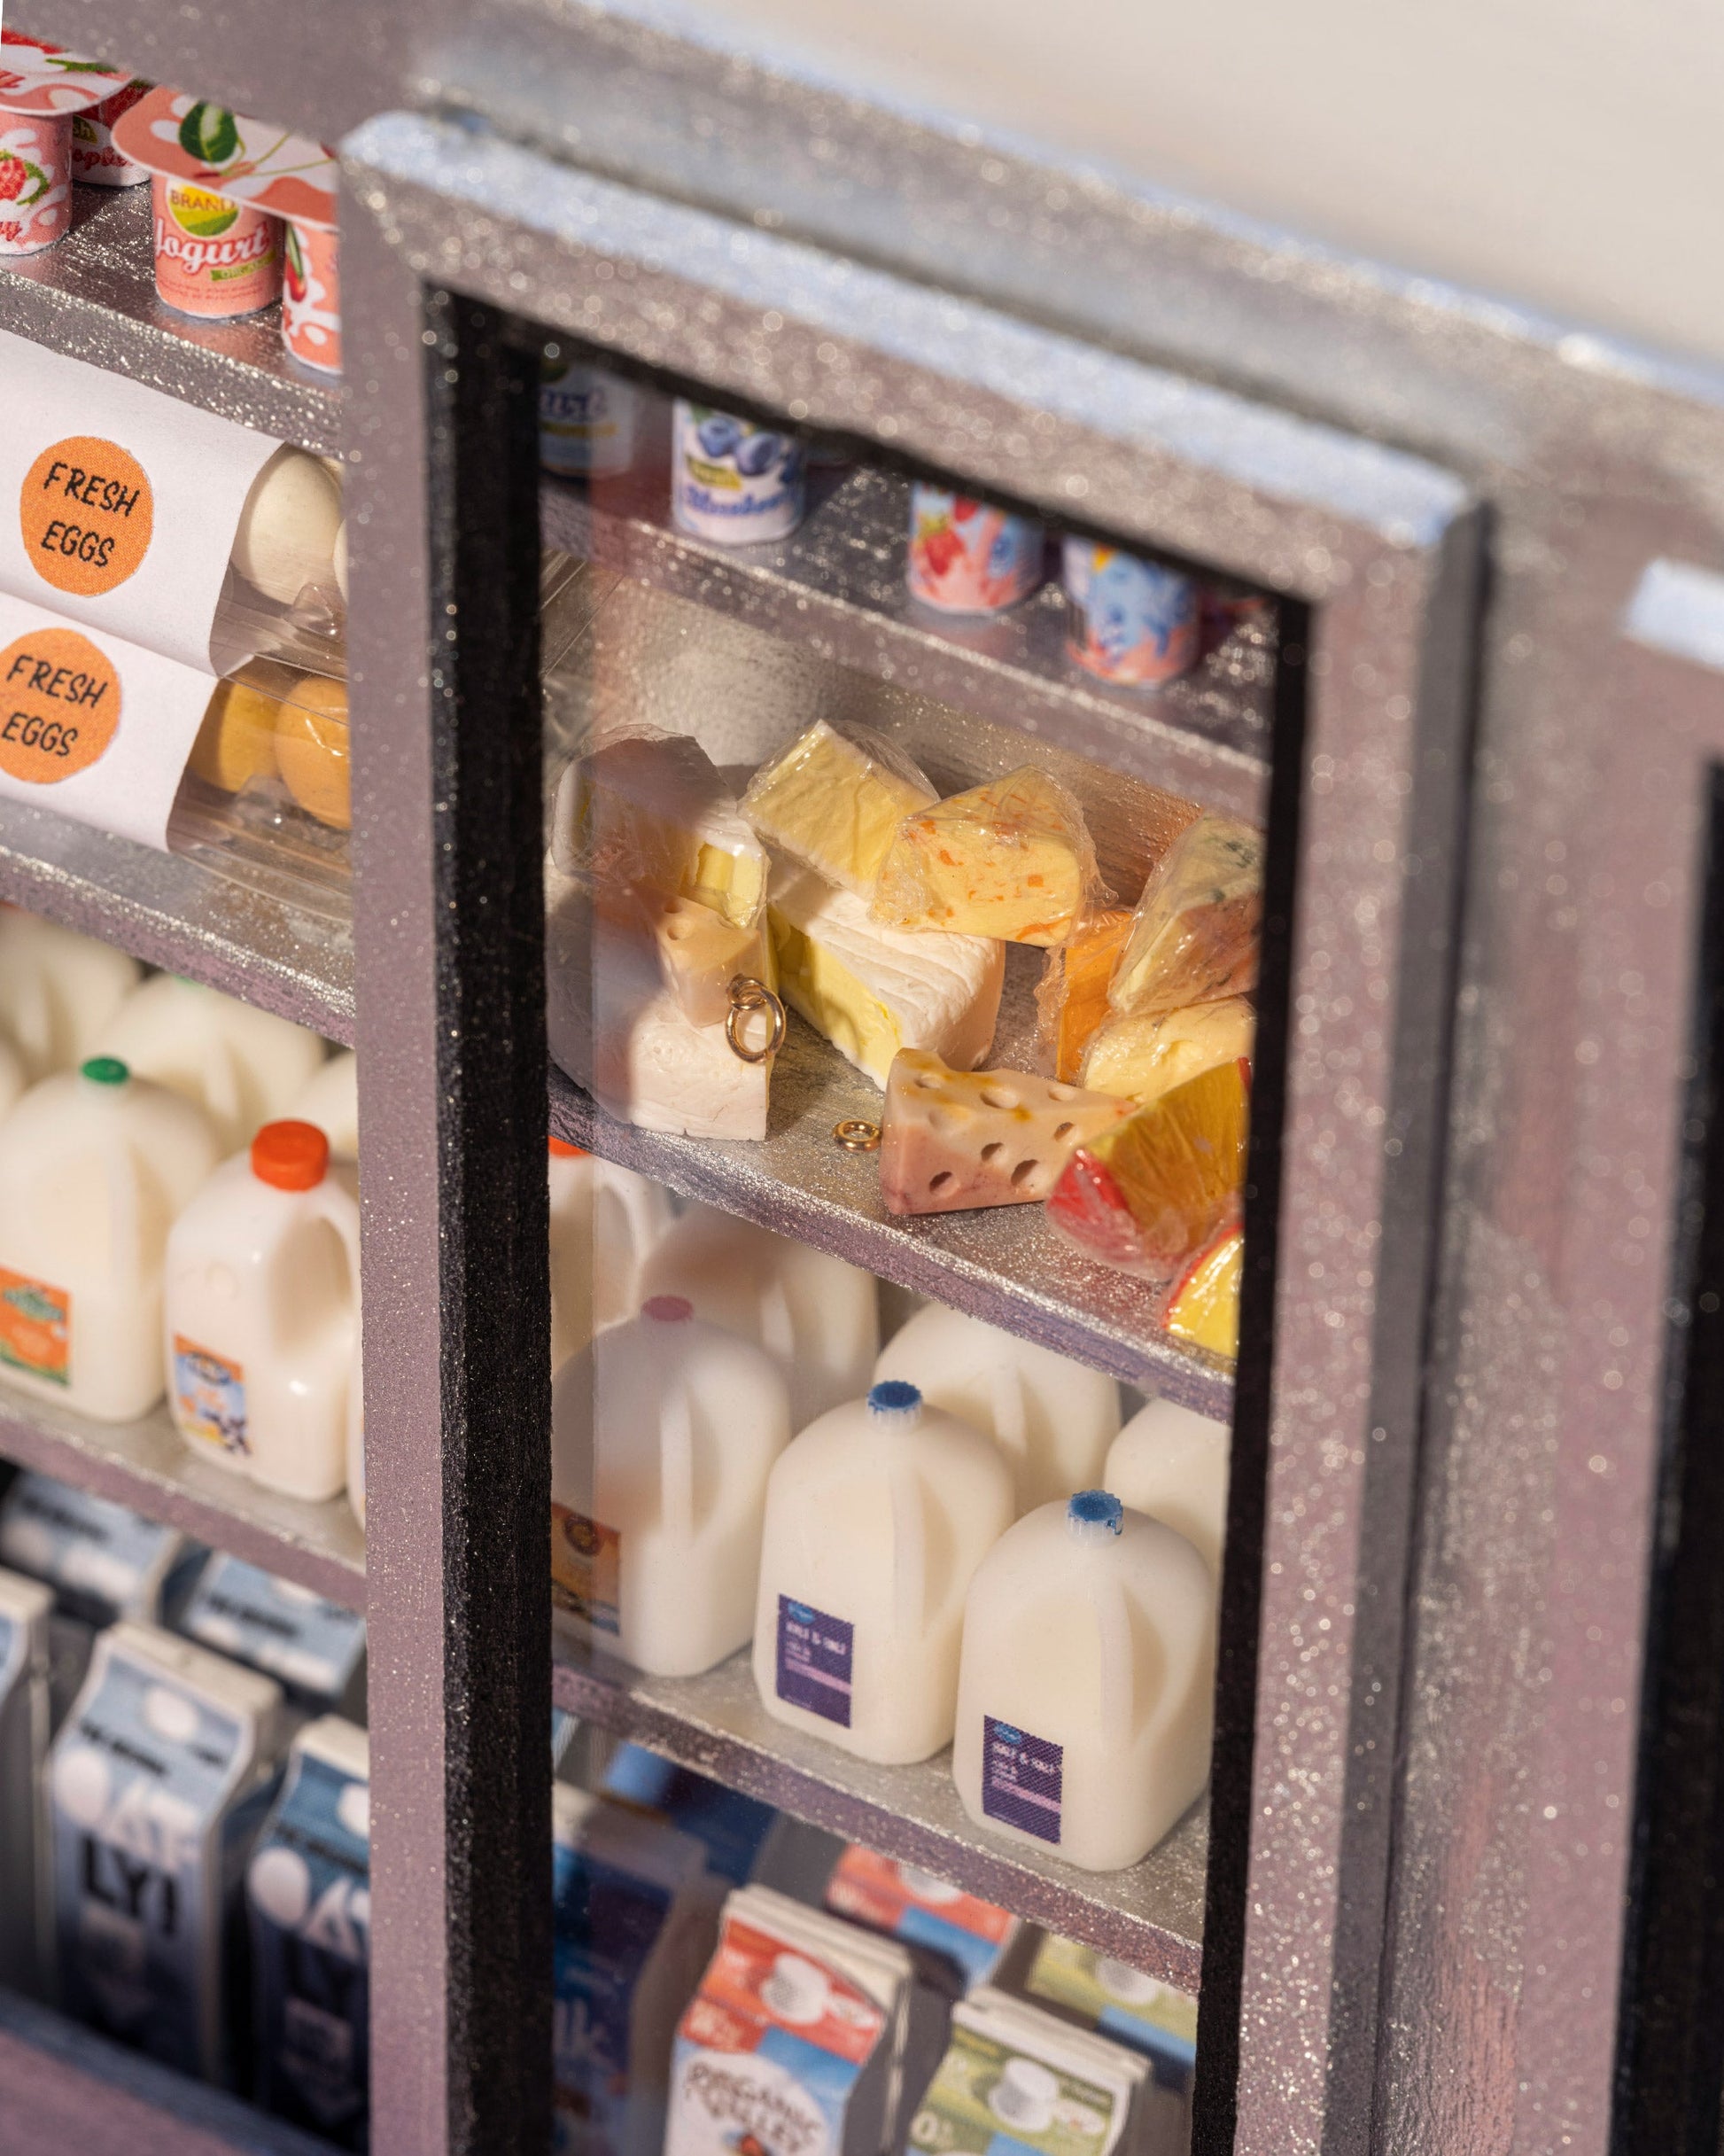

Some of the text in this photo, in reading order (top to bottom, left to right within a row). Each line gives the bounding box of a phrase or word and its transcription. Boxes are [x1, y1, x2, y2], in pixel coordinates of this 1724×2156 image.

[43, 462, 140, 518] FRESH
[41, 520, 115, 568] EGGS
[7, 654, 108, 708] FRESH
[1, 712, 79, 758] EGGS
